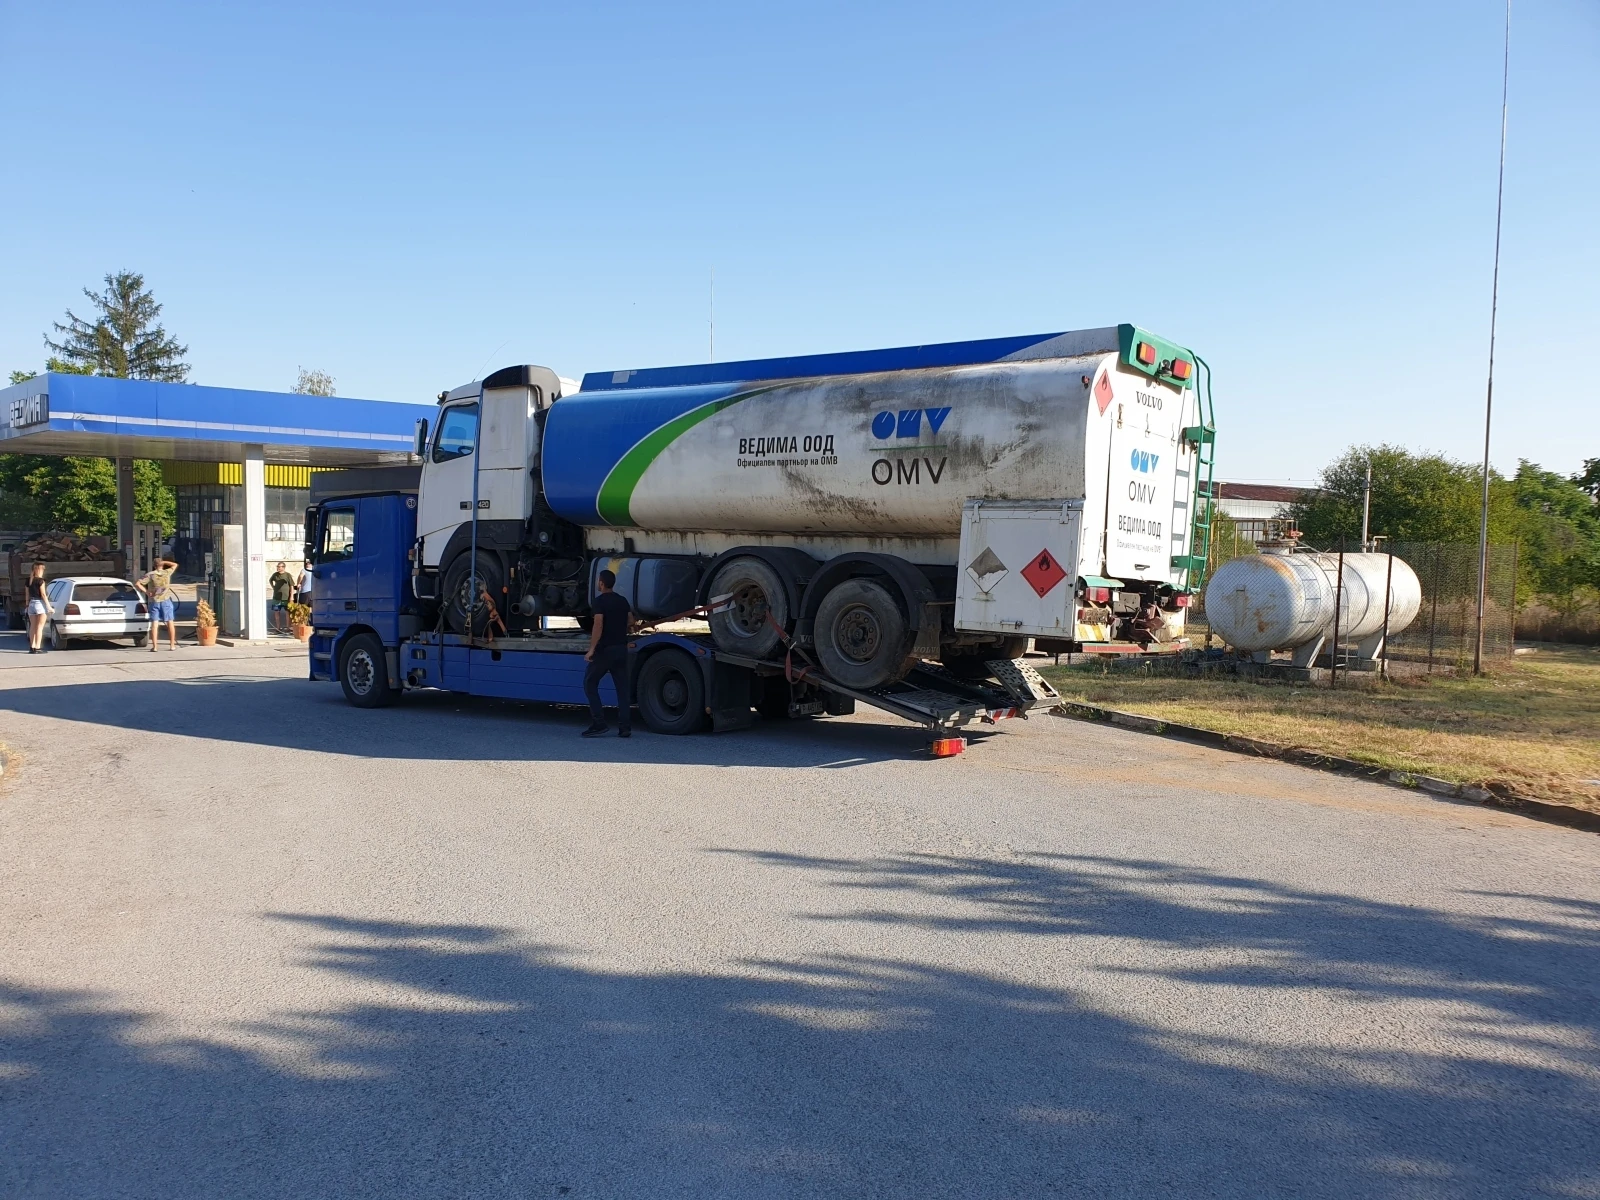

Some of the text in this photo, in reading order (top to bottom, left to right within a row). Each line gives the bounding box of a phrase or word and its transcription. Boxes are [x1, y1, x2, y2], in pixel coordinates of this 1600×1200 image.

[1136, 391, 1163, 411] VOLVO
[871, 406, 953, 440] OMV
[738, 434, 835, 457] ВЕДИМА ООД
[737, 458, 775, 468] Официален
[776, 457, 808, 468] партньор
[820, 455, 838, 466] ОМВ
[871, 456, 948, 486] OMV
[1128, 480, 1156, 505] OMV
[1118, 515, 1162, 540] ВЕДИМА ООД
